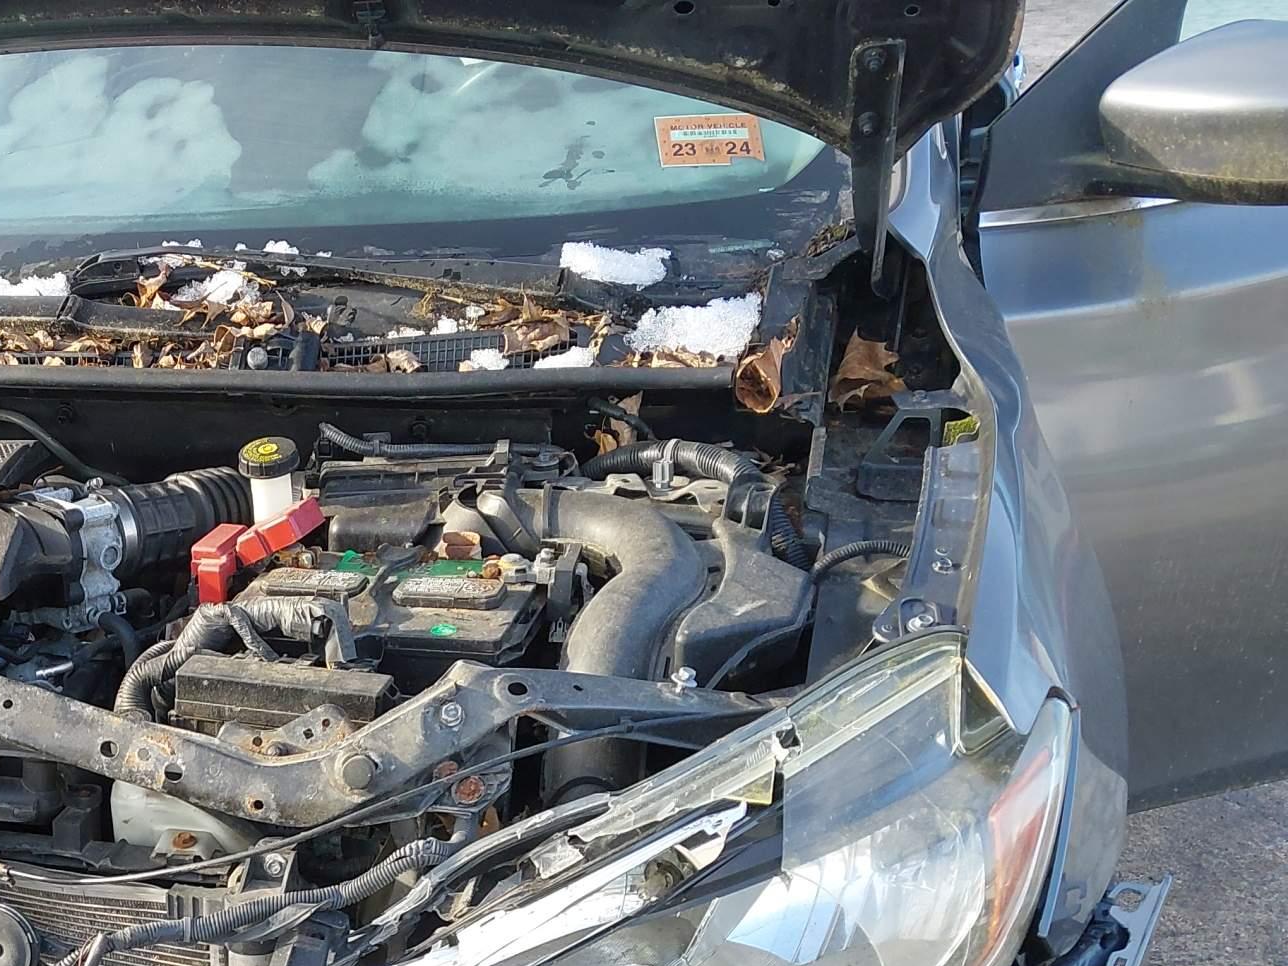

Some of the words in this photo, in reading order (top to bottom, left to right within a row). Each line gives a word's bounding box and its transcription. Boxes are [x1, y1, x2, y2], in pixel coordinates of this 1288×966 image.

[670, 123, 704, 131] MOTOR
[672, 143, 697, 156] 23
[725, 141, 751, 155] 24
